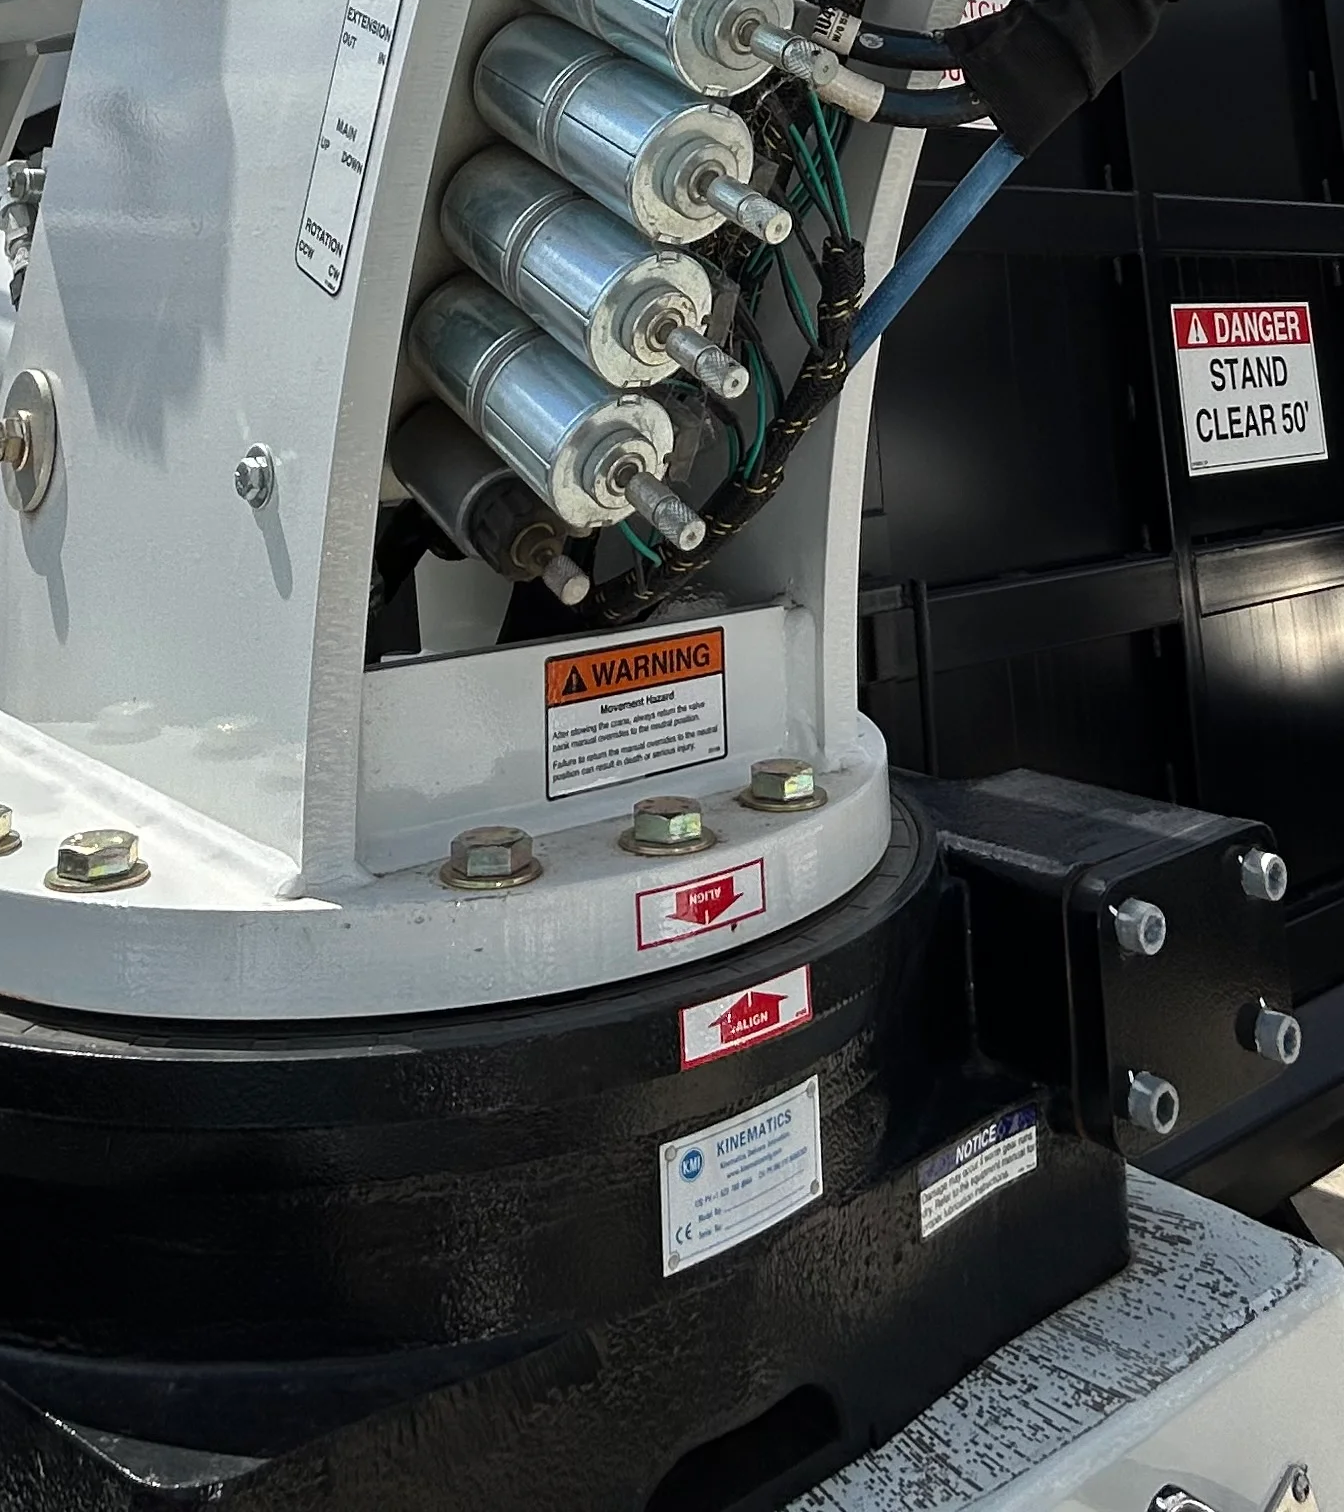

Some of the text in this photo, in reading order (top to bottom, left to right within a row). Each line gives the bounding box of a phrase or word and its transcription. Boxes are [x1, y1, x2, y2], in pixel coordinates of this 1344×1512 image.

[347, 7, 391, 42] EXTENSION
[342, 33, 386, 66] OUT IN
[337, 117, 358, 142] MAIN
[320, 137, 363, 176] UP DOWN
[304, 217, 344, 257] ROTATION
[298, 238, 341, 281] CCW CW
[1214, 310, 1301, 344] DANGER
[1210, 355, 1288, 392] STAND
[1196, 400, 1309, 443] CLEAR 50'
[591, 643, 710, 688] WARNING
[600, 690, 674, 714] Movement Hazard
[689, 886, 722, 906] ALIGN
[736, 1010, 769, 1033] ALIGN
[716, 1108, 793, 1157] KINEMATICS
[955, 1123, 997, 1165] NOTICE
